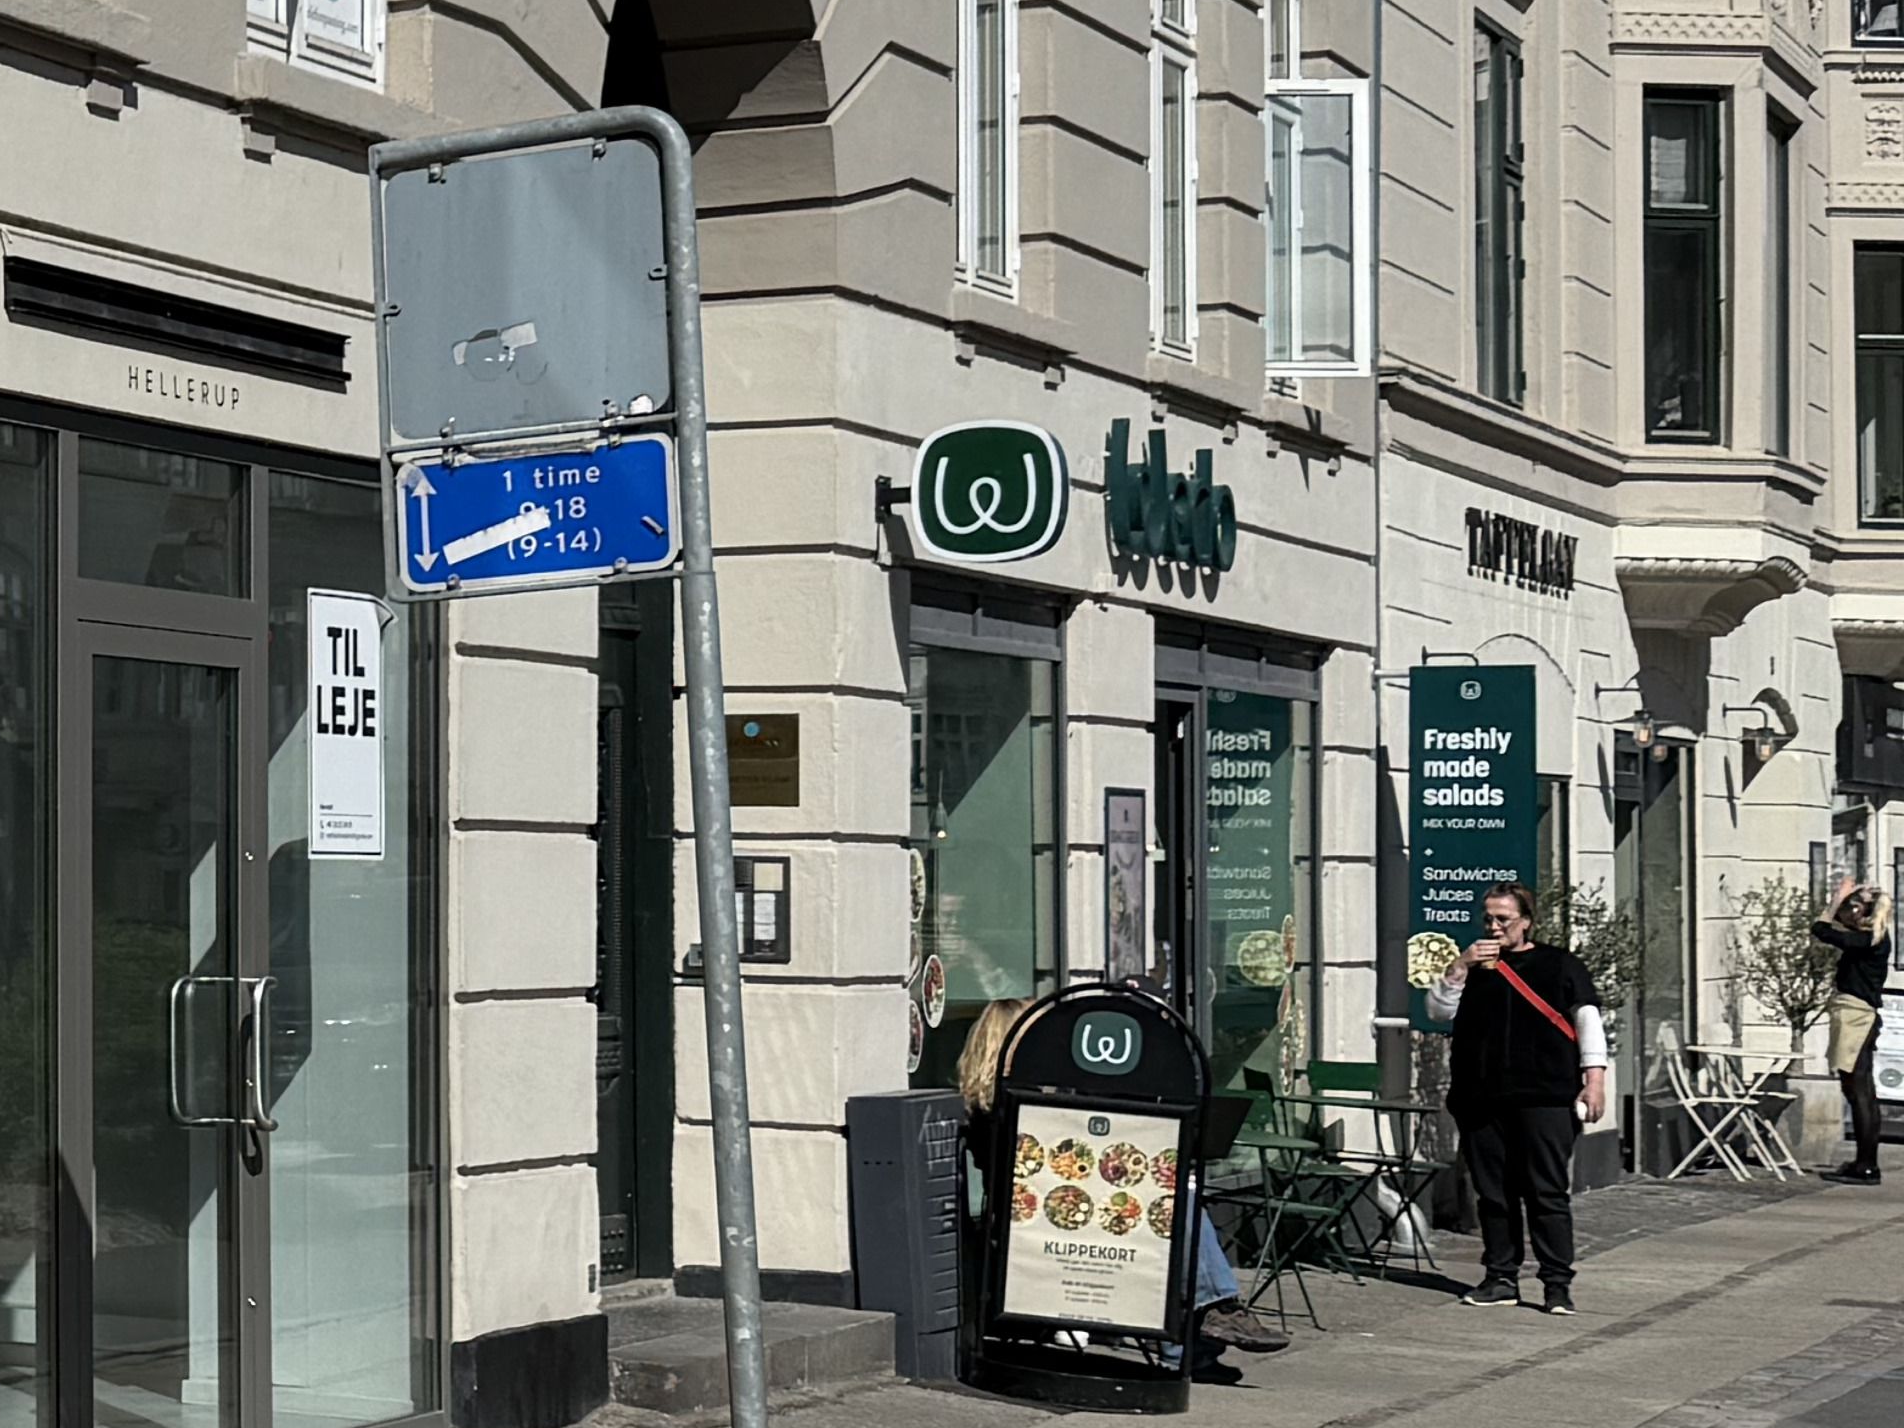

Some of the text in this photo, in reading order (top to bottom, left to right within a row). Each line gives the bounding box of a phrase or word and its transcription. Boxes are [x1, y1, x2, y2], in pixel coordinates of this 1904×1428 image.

[128, 365, 240, 410] HELLERUP
[502, 465, 601, 492] 1 time
[506, 526, 602, 561] (9-14)
[326, 625, 365, 678] TIL
[316, 684, 376, 737] LEJE
[1423, 727, 1512, 755] Freshly
[1423, 755, 1491, 778] made
[1422, 783, 1505, 807] salads
[1422, 866, 1518, 882] Sandwiches
[1422, 888, 1474, 902] Juices
[1422, 907, 1471, 923] Treats
[1043, 1241, 1137, 1263] KLIPPEKORT
